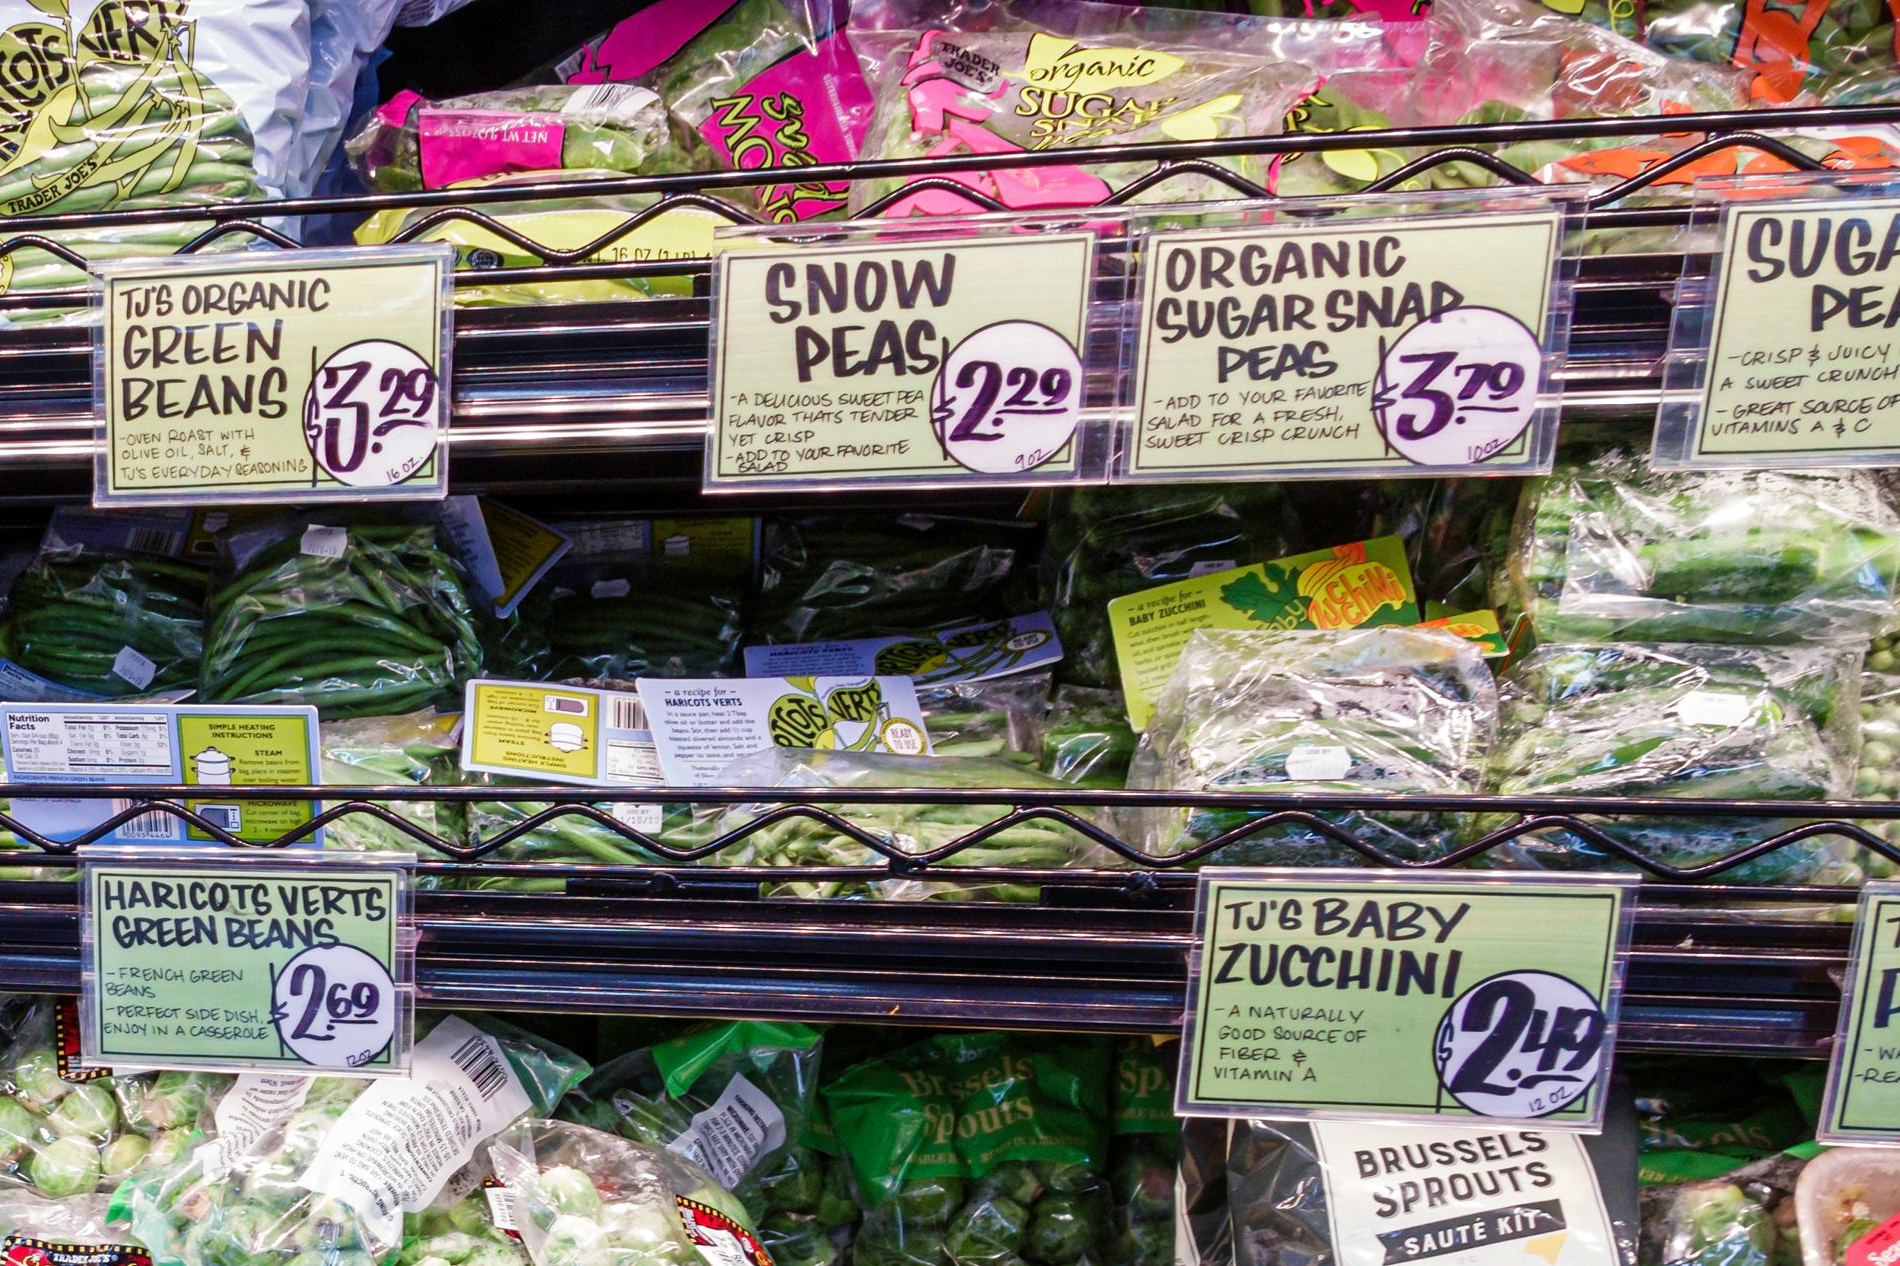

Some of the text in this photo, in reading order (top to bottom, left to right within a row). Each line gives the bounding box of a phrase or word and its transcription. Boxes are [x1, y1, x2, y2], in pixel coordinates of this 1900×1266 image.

[8, 158, 99, 214] TRADER JOE'S
[1167, 238, 1406, 292] ORGANIC
[119, 280, 329, 318] TJ'S ORGANIC
[767, 255, 956, 324] SNOW
[1158, 281, 1464, 342] SUGAR SNAP
[122, 320, 282, 369] GREEN
[799, 322, 941, 382] PEAS
[1219, 342, 1339, 382] PEAS
[121, 368, 290, 420] BEANS
[729, 408, 916, 427] FLAVOR TENDER
[1147, 425, 1358, 447] SWEET CRISP CRUNCH
[1711, 420, 1800, 436] VITAMINS
[121, 447, 160, 461] OLIVE
[665, 698, 742, 707] HARICOTS VERTS
[208, 723, 275, 732] SIMPLE HEATING
[212, 731, 273, 739] INSTRUCTIONS
[104, 881, 385, 921] HARICOTS VERTS
[113, 915, 338, 949] GREEN BEANS
[1225, 901, 1471, 943] TJ'S BABY
[1214, 943, 1462, 998] ZUCCHINI
[104, 1023, 268, 1041] ENJOY CASSEROLE
[1219, 1028, 1343, 1043] GOOD SOURCE
[1214, 1068, 1295, 1081] VITAMIN
[1356, 1132, 1547, 1179] BRUSSELS
[1375, 1162, 1554, 1216] SPROUTS
[1405, 1210, 1539, 1255] SAUTÉ KIT
